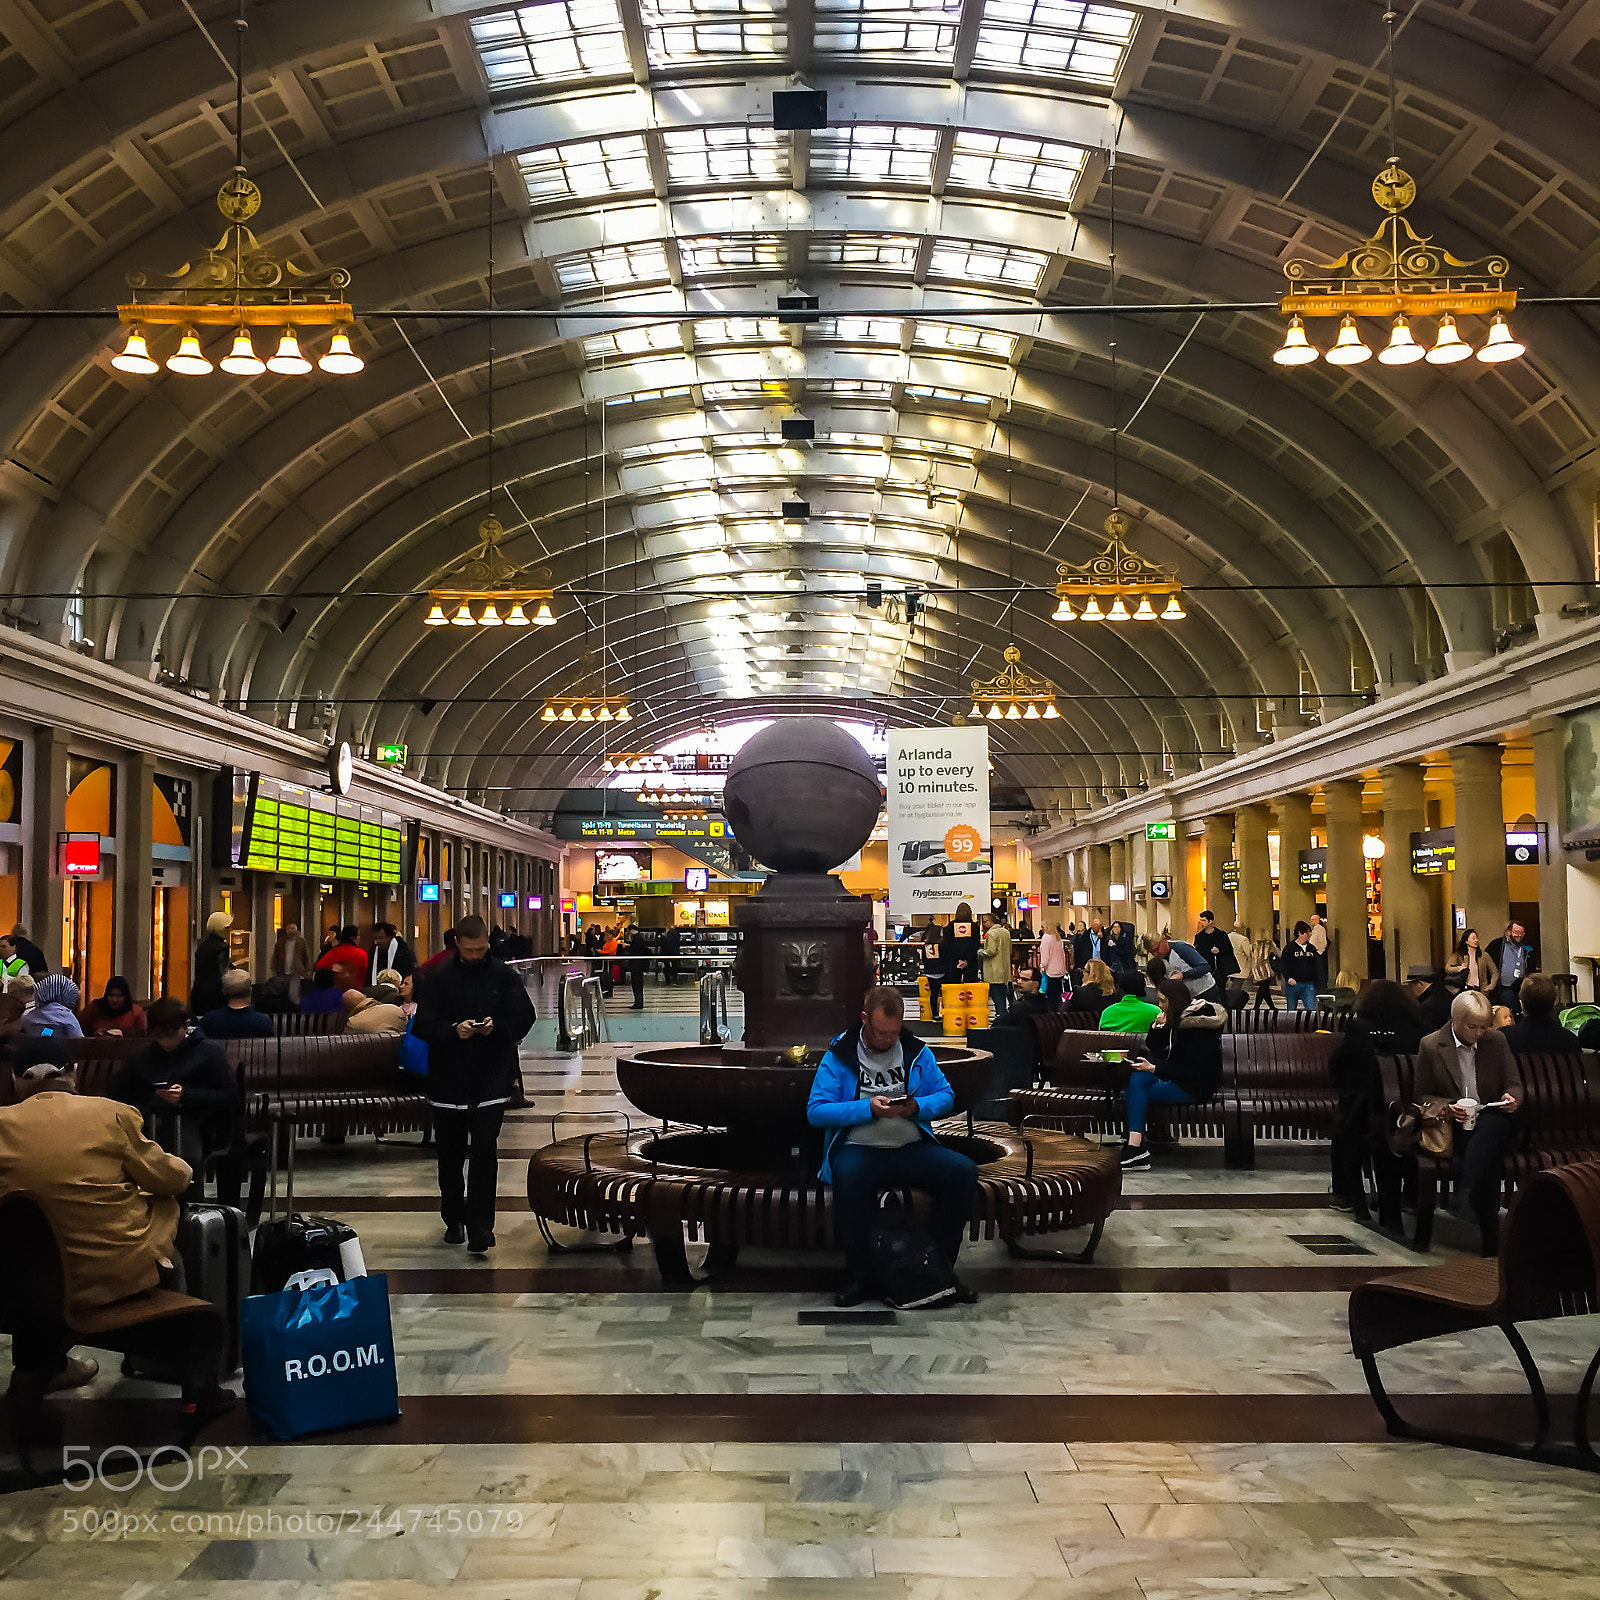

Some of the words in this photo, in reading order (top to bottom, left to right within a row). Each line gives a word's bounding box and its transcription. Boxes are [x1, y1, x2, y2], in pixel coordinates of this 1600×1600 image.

[898, 747, 952, 760] Arlanda
[898, 767, 916, 779] up
[919, 765, 934, 777] to
[936, 766, 974, 778] every
[898, 781, 915, 794] 10
[918, 780, 978, 793] minutes.
[951, 838, 974, 853] 99
[912, 888, 963, 899] Flygbussarna
[285, 1343, 385, 1382] R.O.O.M.
